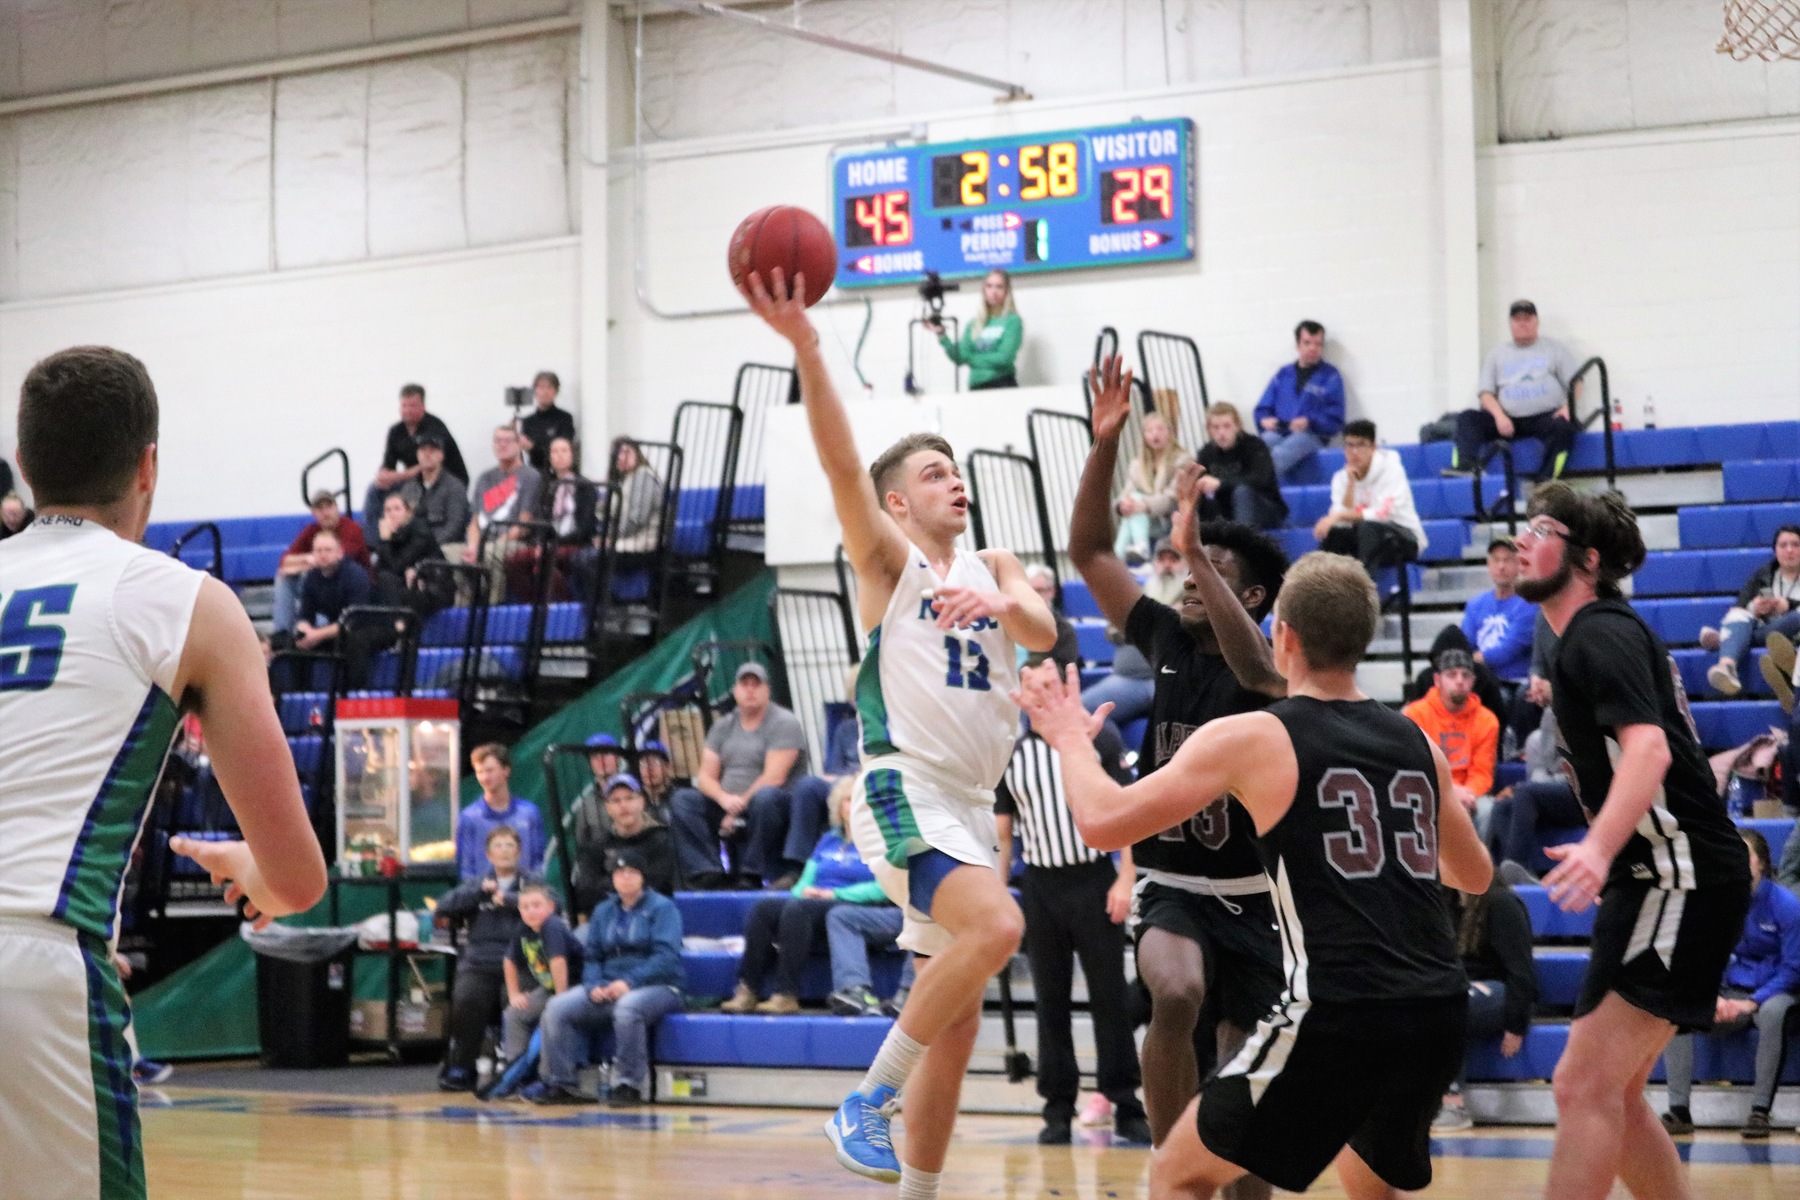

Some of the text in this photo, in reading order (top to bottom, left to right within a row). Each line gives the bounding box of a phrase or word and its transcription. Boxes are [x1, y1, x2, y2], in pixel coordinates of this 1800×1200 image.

[1092, 129, 1178, 163] VISITOR
[847, 157, 909, 188] HOME
[960, 141, 1078, 206] 2:58
[1112, 164, 1173, 225] 29
[856, 190, 913, 246] 45
[961, 229, 1018, 253] PERIOD
[1036, 217, 1049, 262] 1
[1089, 230, 1143, 256] BONUS
[872, 249, 925, 274] BONUS
[0, 583, 79, 693] 5
[944, 635, 992, 692] 13
[1316, 767, 1439, 881] 33
